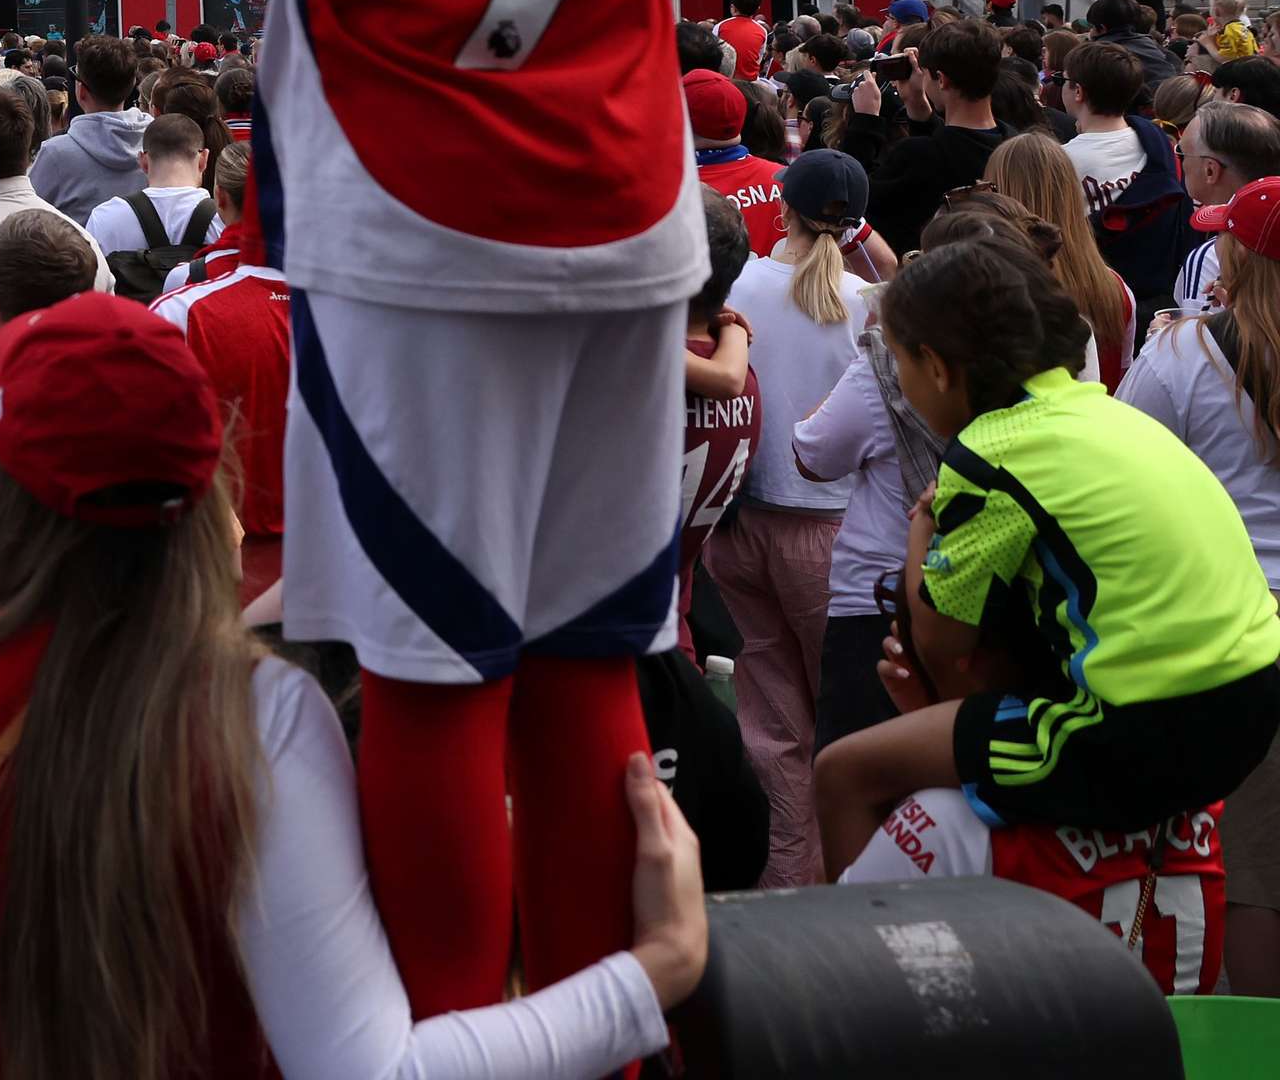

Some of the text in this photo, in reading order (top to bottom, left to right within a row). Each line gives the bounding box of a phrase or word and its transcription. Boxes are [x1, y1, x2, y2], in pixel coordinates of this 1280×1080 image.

[684, 395, 754, 428] HENRY
[682, 438, 751, 542] 14
[883, 814, 937, 874] ANDA
[1055, 811, 1216, 874] BLACO
